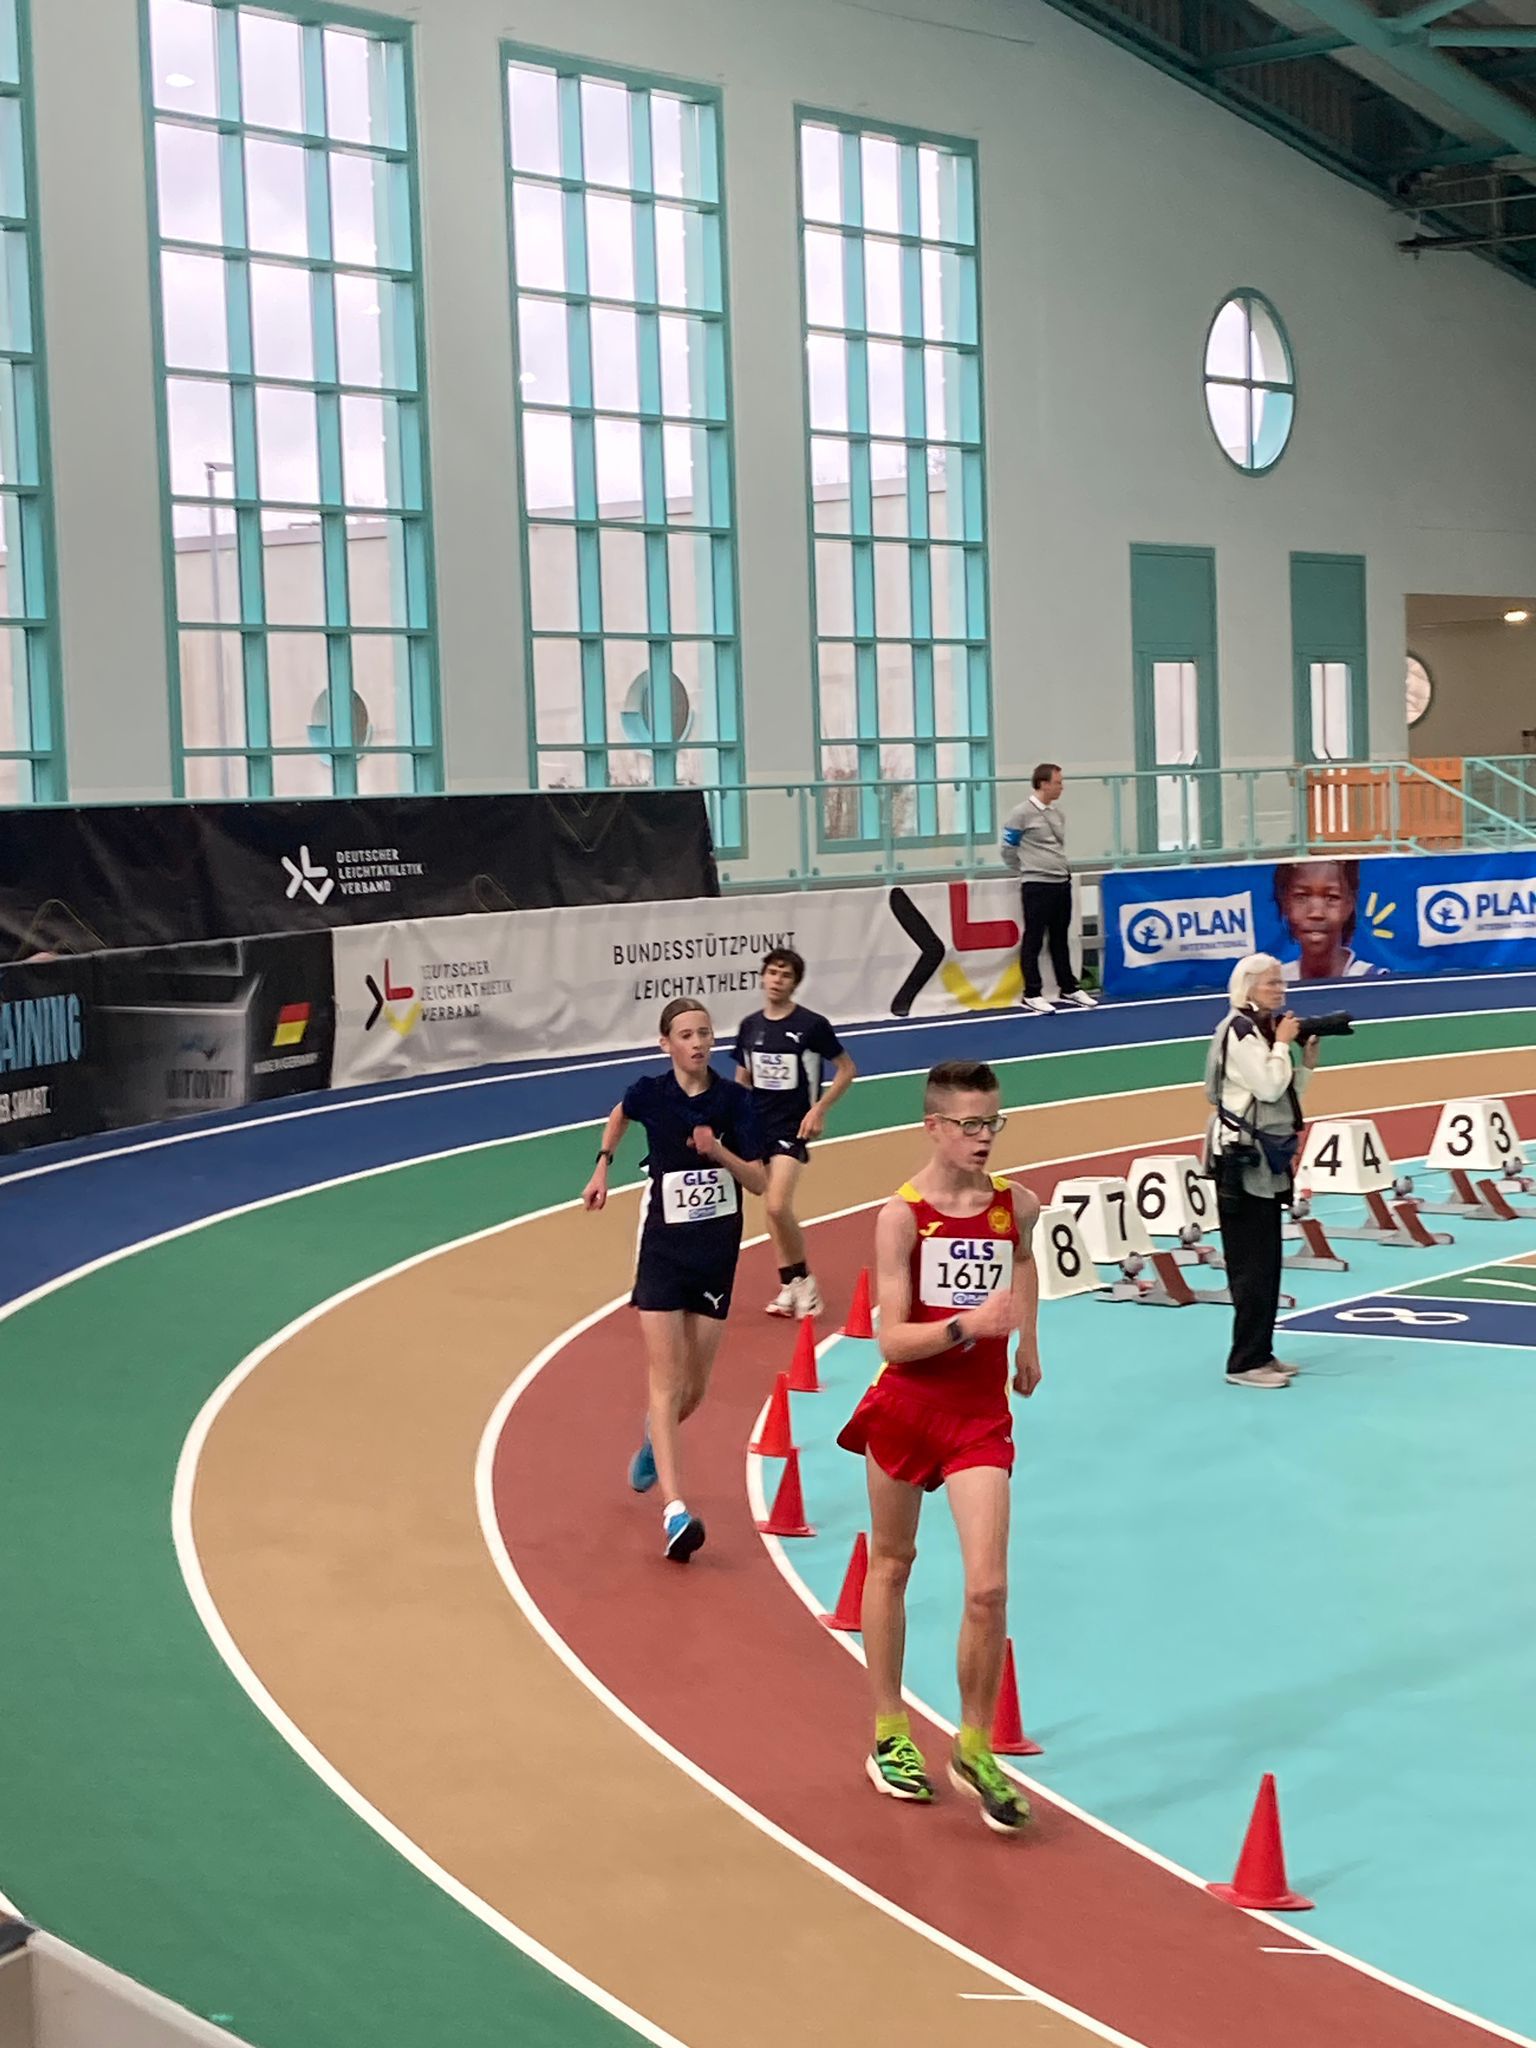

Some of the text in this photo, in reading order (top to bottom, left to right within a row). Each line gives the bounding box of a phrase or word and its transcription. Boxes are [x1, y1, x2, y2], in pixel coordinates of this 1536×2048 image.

[336, 848, 399, 863] DEUTSCHER
[338, 863, 424, 879] LEICHTATHLETIK
[341, 880, 391, 895] VERBAND
[1177, 908, 1247, 938] PLAN
[613, 932, 795, 965] BUNDESSTÜTZPUNKT
[635, 970, 765, 1000] LEICHTATHLET
[420, 1004, 480, 1021] VERBAND
[1447, 1114, 1473, 1157] 3
[1490, 1111, 1511, 1153] 3
[1313, 1134, 1342, 1176] 4
[1362, 1131, 1381, 1174] 4
[683, 1170, 718, 1186] GLS
[1185, 1169, 1206, 1217] 6
[674, 1185, 728, 1208] 1621
[1062, 1195, 1090, 1222] 7
[1137, 1171, 1166, 1220] 6
[1106, 1191, 1127, 1241] 7
[950, 1240, 994, 1261] GLS
[1052, 1224, 1081, 1277] 8
[937, 1262, 1003, 1290] 1617
[1334, 1307, 1470, 1326] 8
